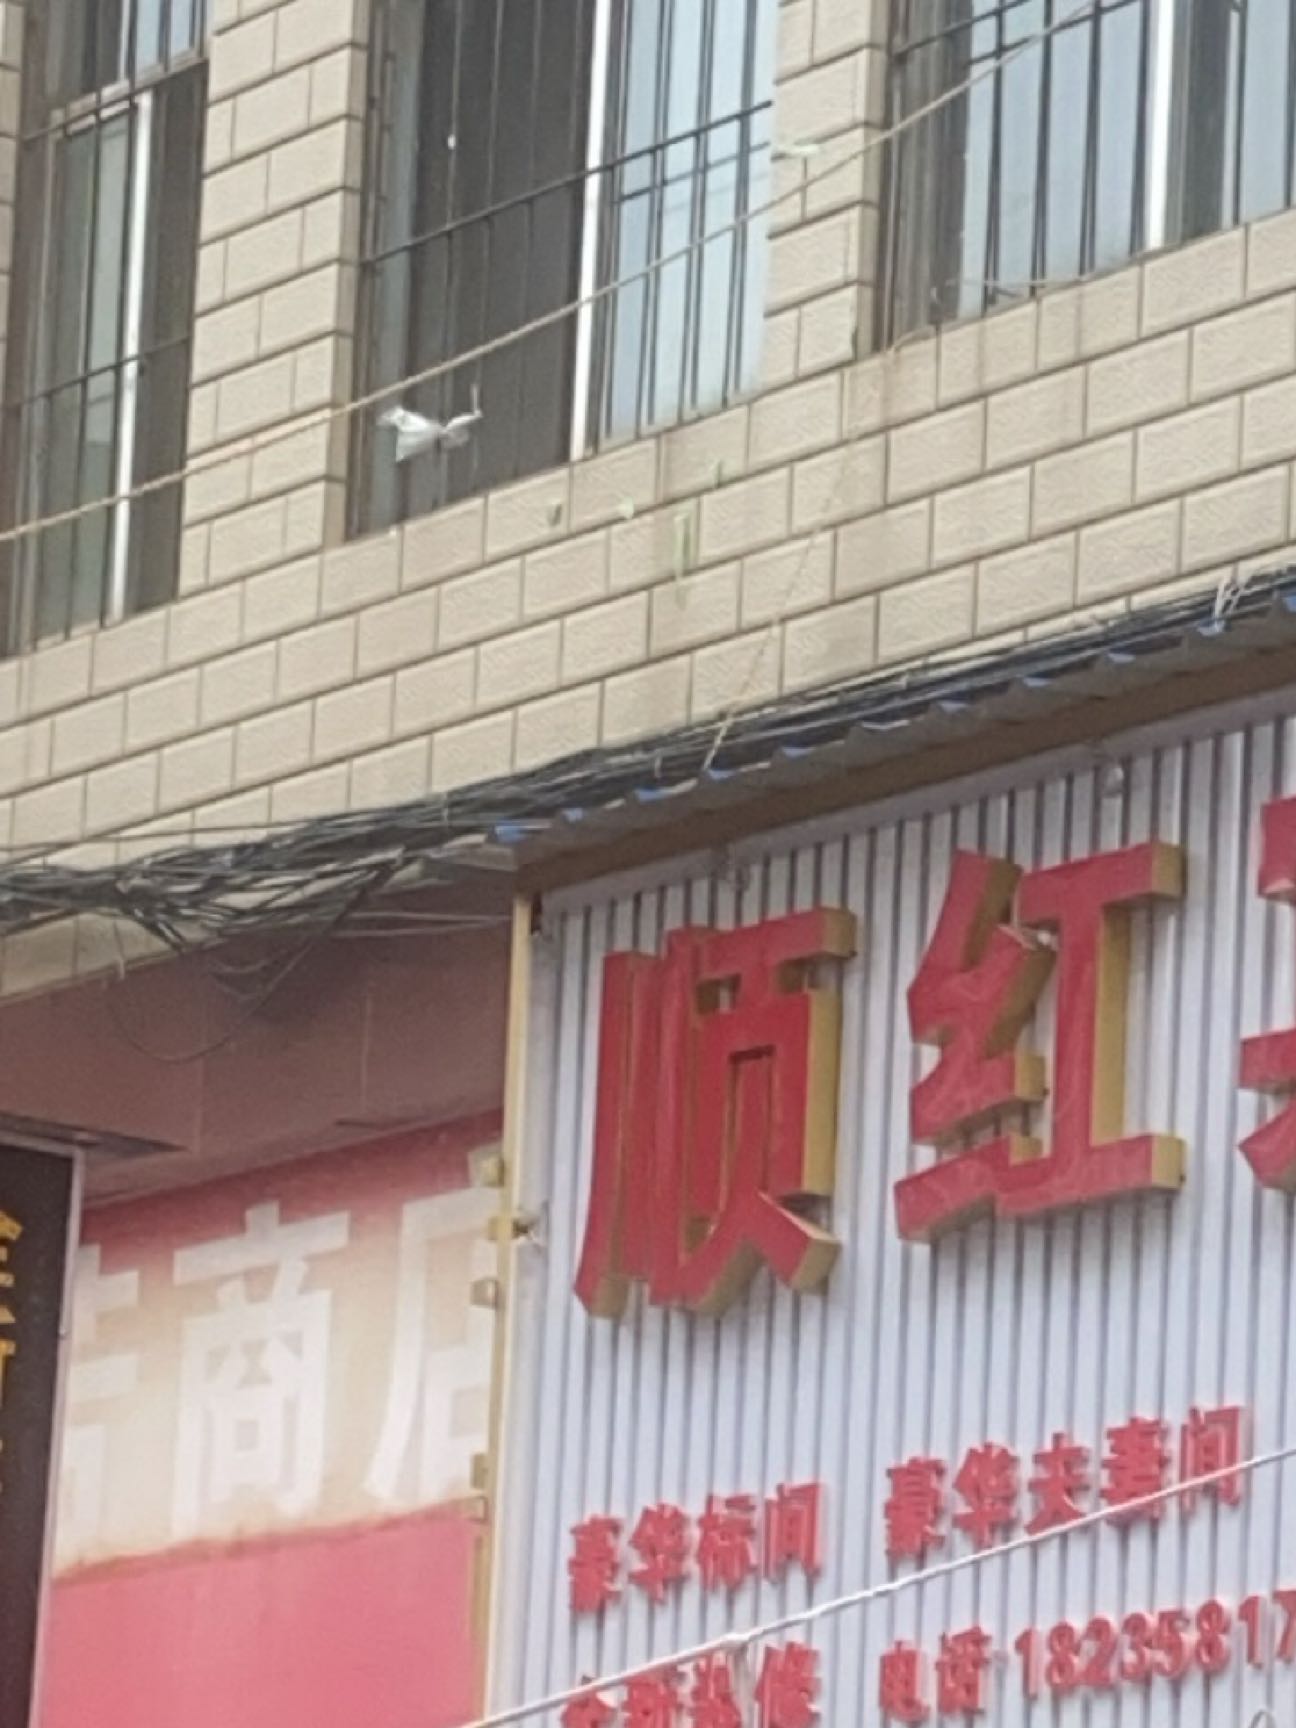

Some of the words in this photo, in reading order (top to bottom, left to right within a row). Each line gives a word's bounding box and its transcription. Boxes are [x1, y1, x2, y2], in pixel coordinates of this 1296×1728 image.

[568, 1482, 823, 1614] 豪华标间
[884, 1404, 1244, 1565] 豪华夫妻间
